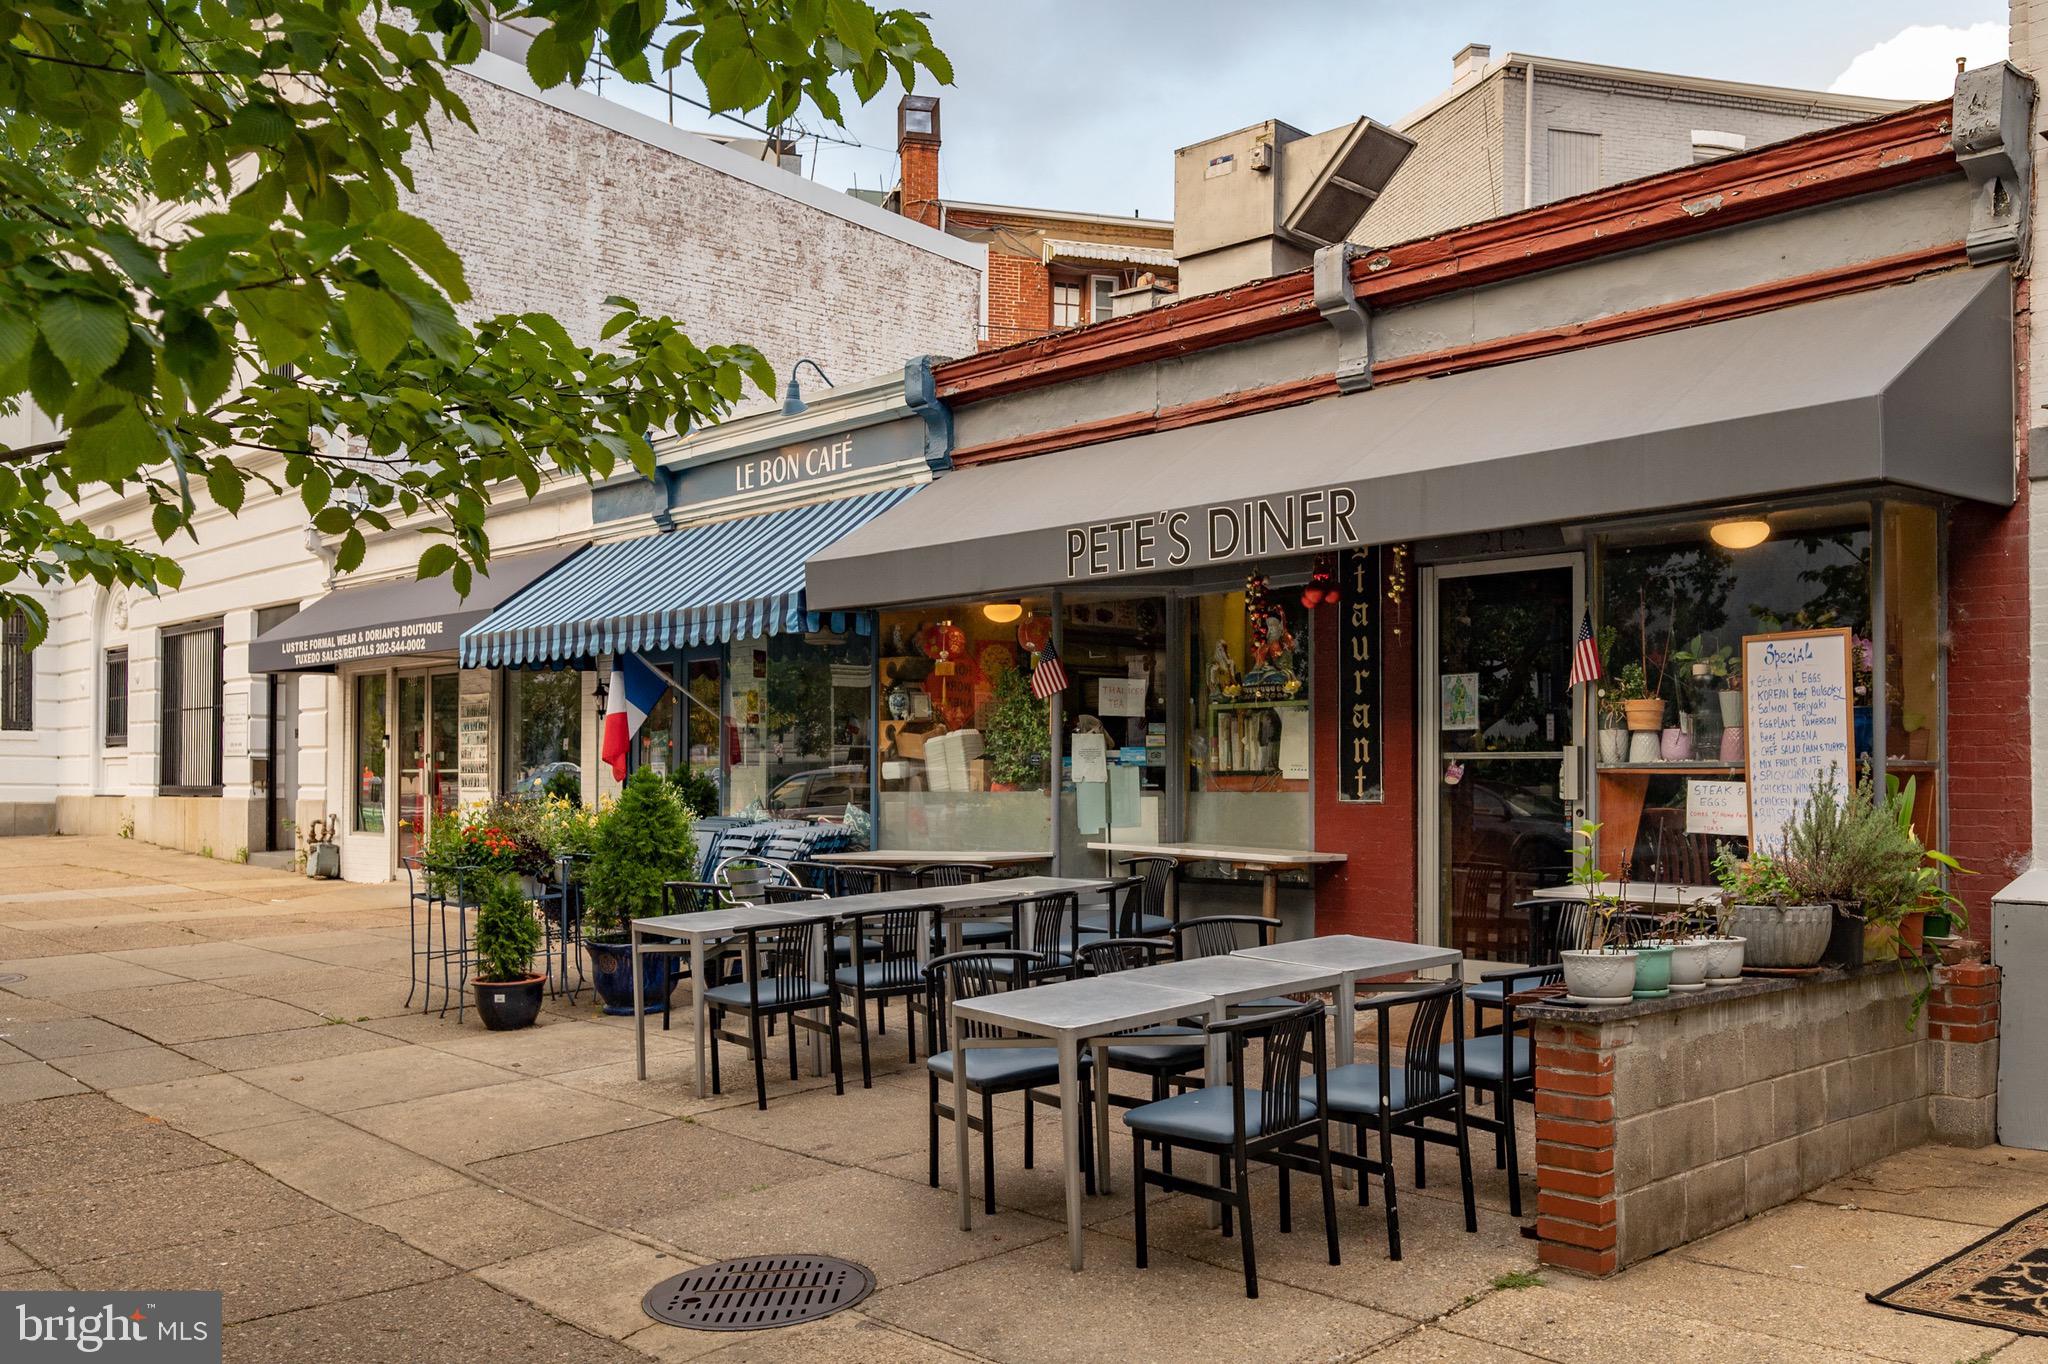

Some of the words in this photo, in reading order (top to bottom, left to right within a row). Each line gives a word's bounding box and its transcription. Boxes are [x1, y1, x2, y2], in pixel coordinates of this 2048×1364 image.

[736, 463, 754, 491] LE
[760, 453, 799, 486] BON
[805, 434, 853, 476] CAFÉ
[1066, 510, 1191, 578] PETE'S
[1208, 487, 1359, 561] DINER
[282, 641, 309, 654] LUSTRE
[309, 637, 336, 650] FORMAL
[337, 633, 357, 646] WEAR
[358, 633, 364, 643] &
[365, 627, 400, 641] DORIAN'S
[401, 621, 443, 637] BOUTIQUE
[294, 652, 321, 666] TUXEDO
[321, 644, 374, 661] SALES/RENTALS
[375, 638, 426, 655] 202-544-0002
[1102, 685, 1124, 695] THAI
[1757, 688, 1789, 702] KOREAN
[1109, 699, 1124, 708] TEA
[1760, 746, 1777, 757] CHEF
[1780, 744, 1801, 755] SALAD
[1759, 759, 1772, 769] MIX
[1775, 757, 1798, 768] FRUITS
[1801, 755, 1821, 766] PLATE
[1694, 784, 1732, 796] STEAK
[1760, 783, 1792, 794] CHICKEN
[1699, 797, 1727, 807] EGGS
